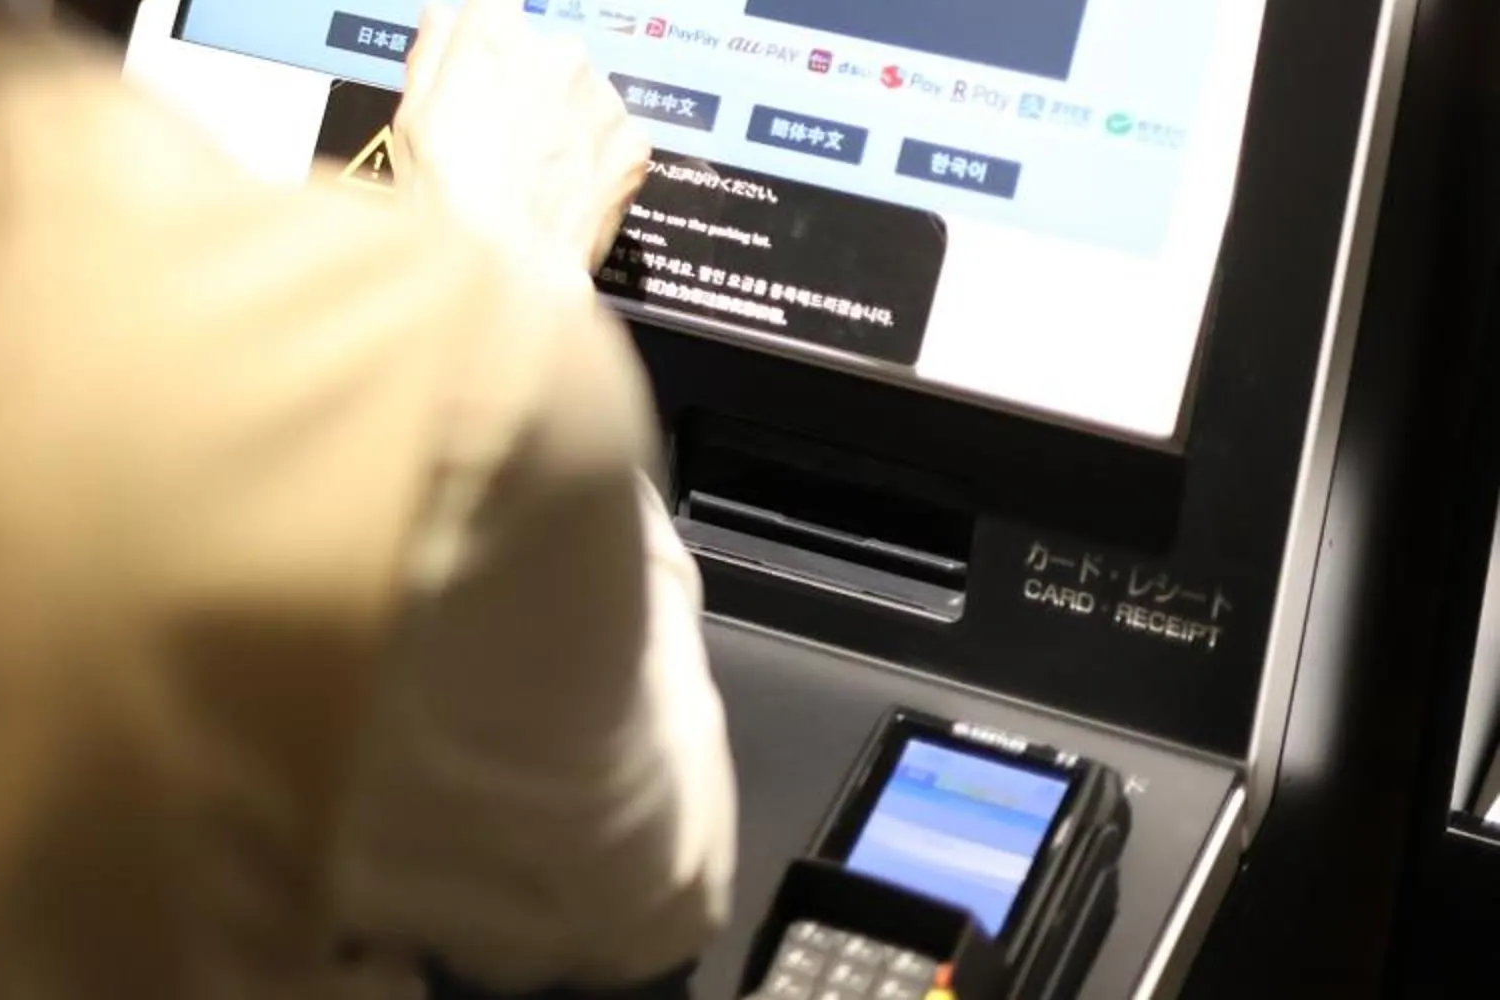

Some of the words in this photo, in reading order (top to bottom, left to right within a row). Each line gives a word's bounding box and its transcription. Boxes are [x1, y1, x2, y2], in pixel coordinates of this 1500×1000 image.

[356, 25, 409, 52] 日本語
[930, 150, 988, 183] 한국어
